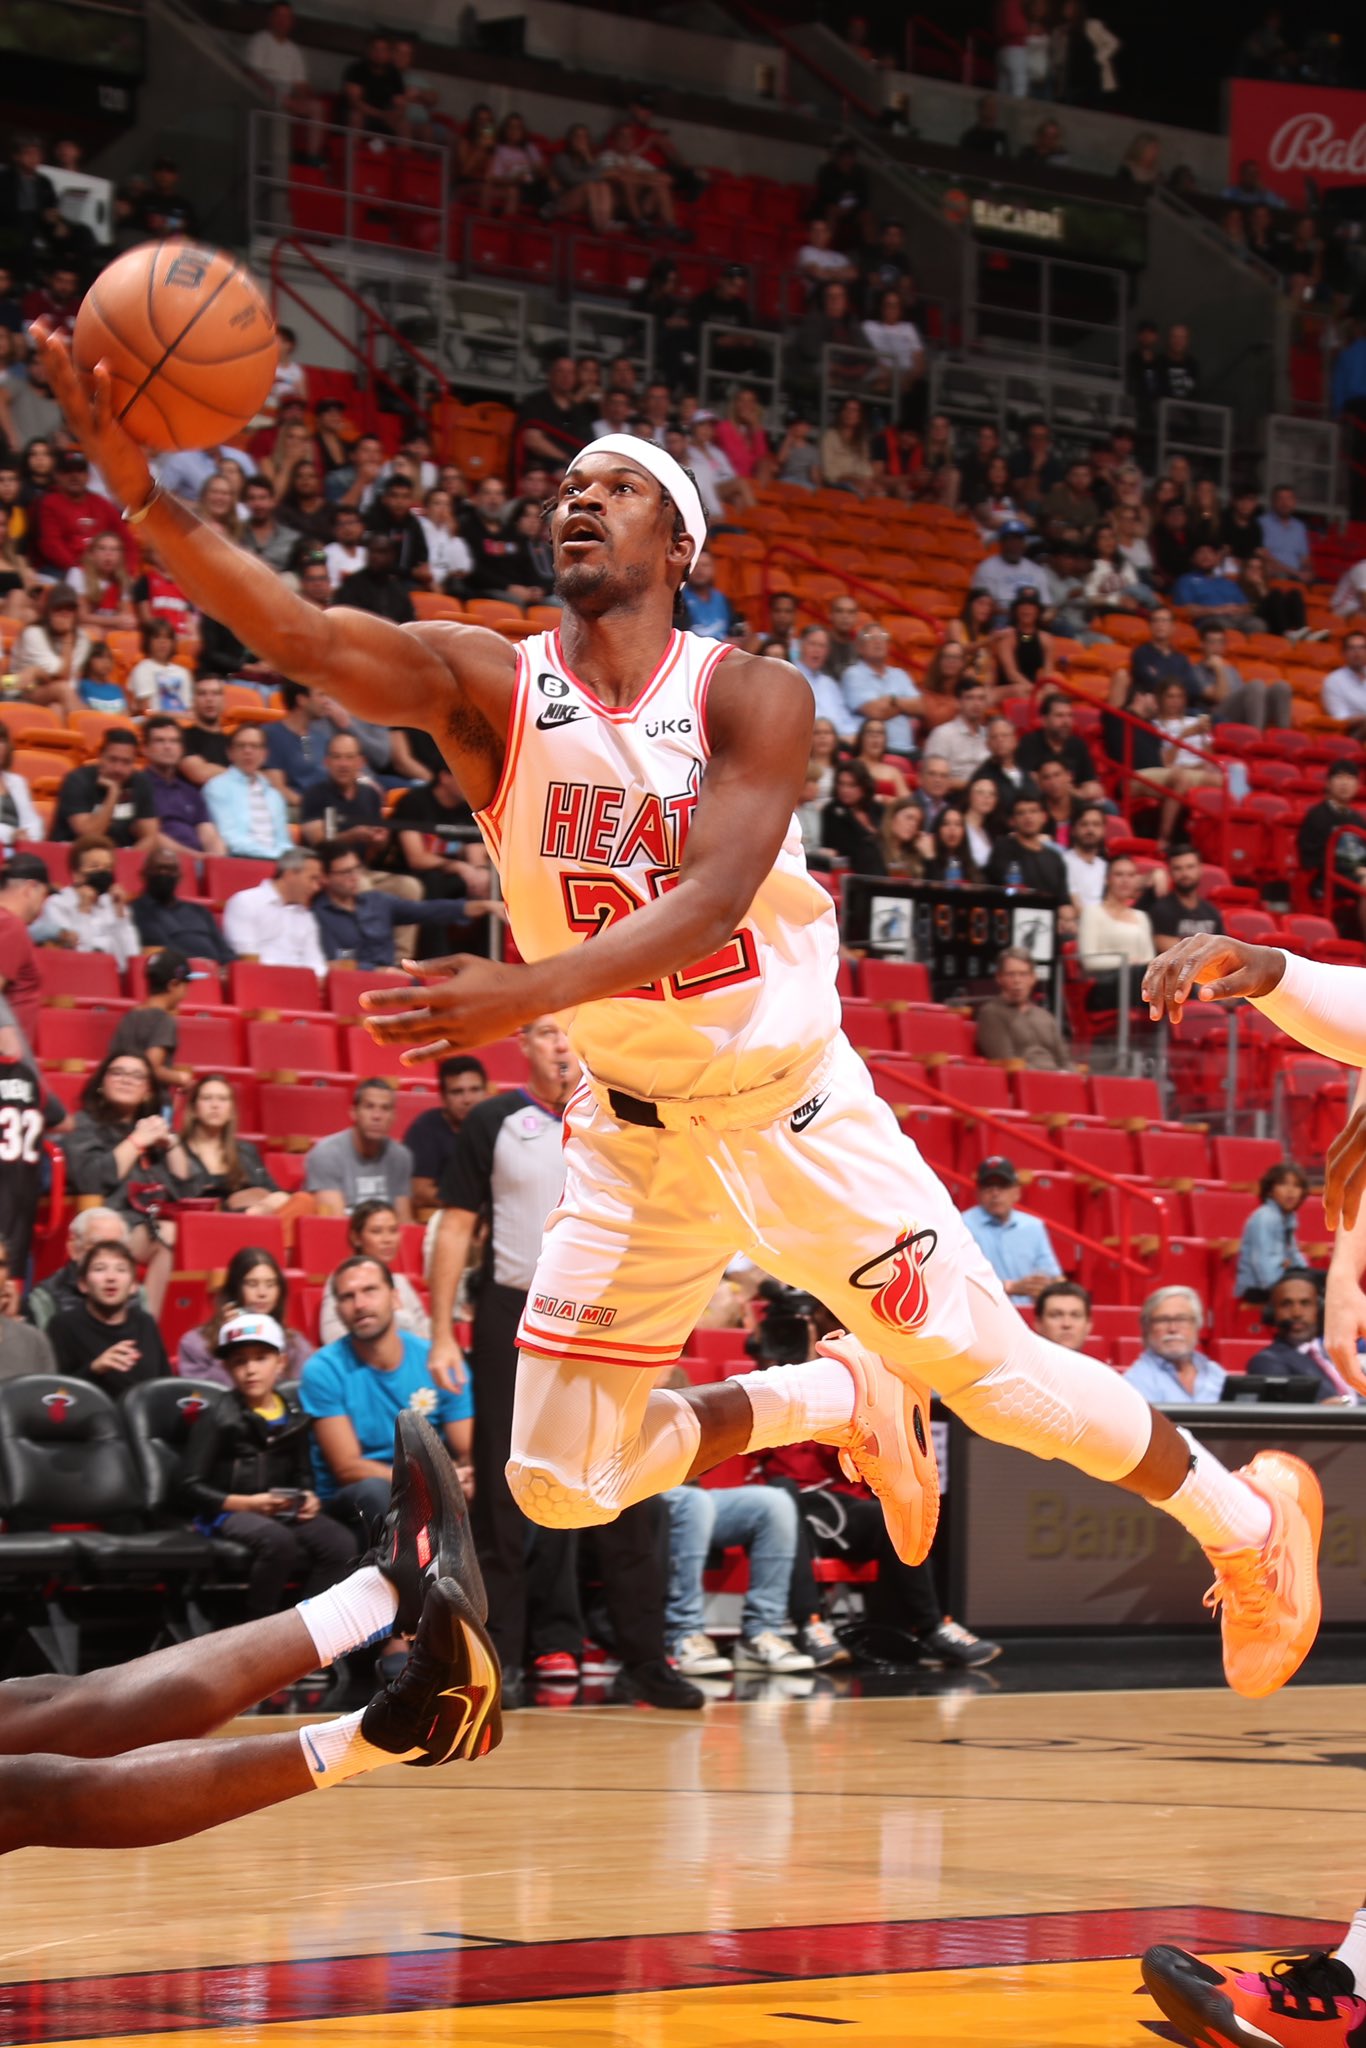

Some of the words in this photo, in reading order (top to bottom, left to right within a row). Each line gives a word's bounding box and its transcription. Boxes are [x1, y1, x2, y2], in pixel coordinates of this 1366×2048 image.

[543, 676, 563, 698] 6
[543, 702, 580, 720] NIKE
[792, 1096, 821, 1121] NIKE
[0, 1107, 43, 1163] 32
[532, 1293, 618, 1327] MIAMI
[1025, 1490, 1156, 1562] Bam
